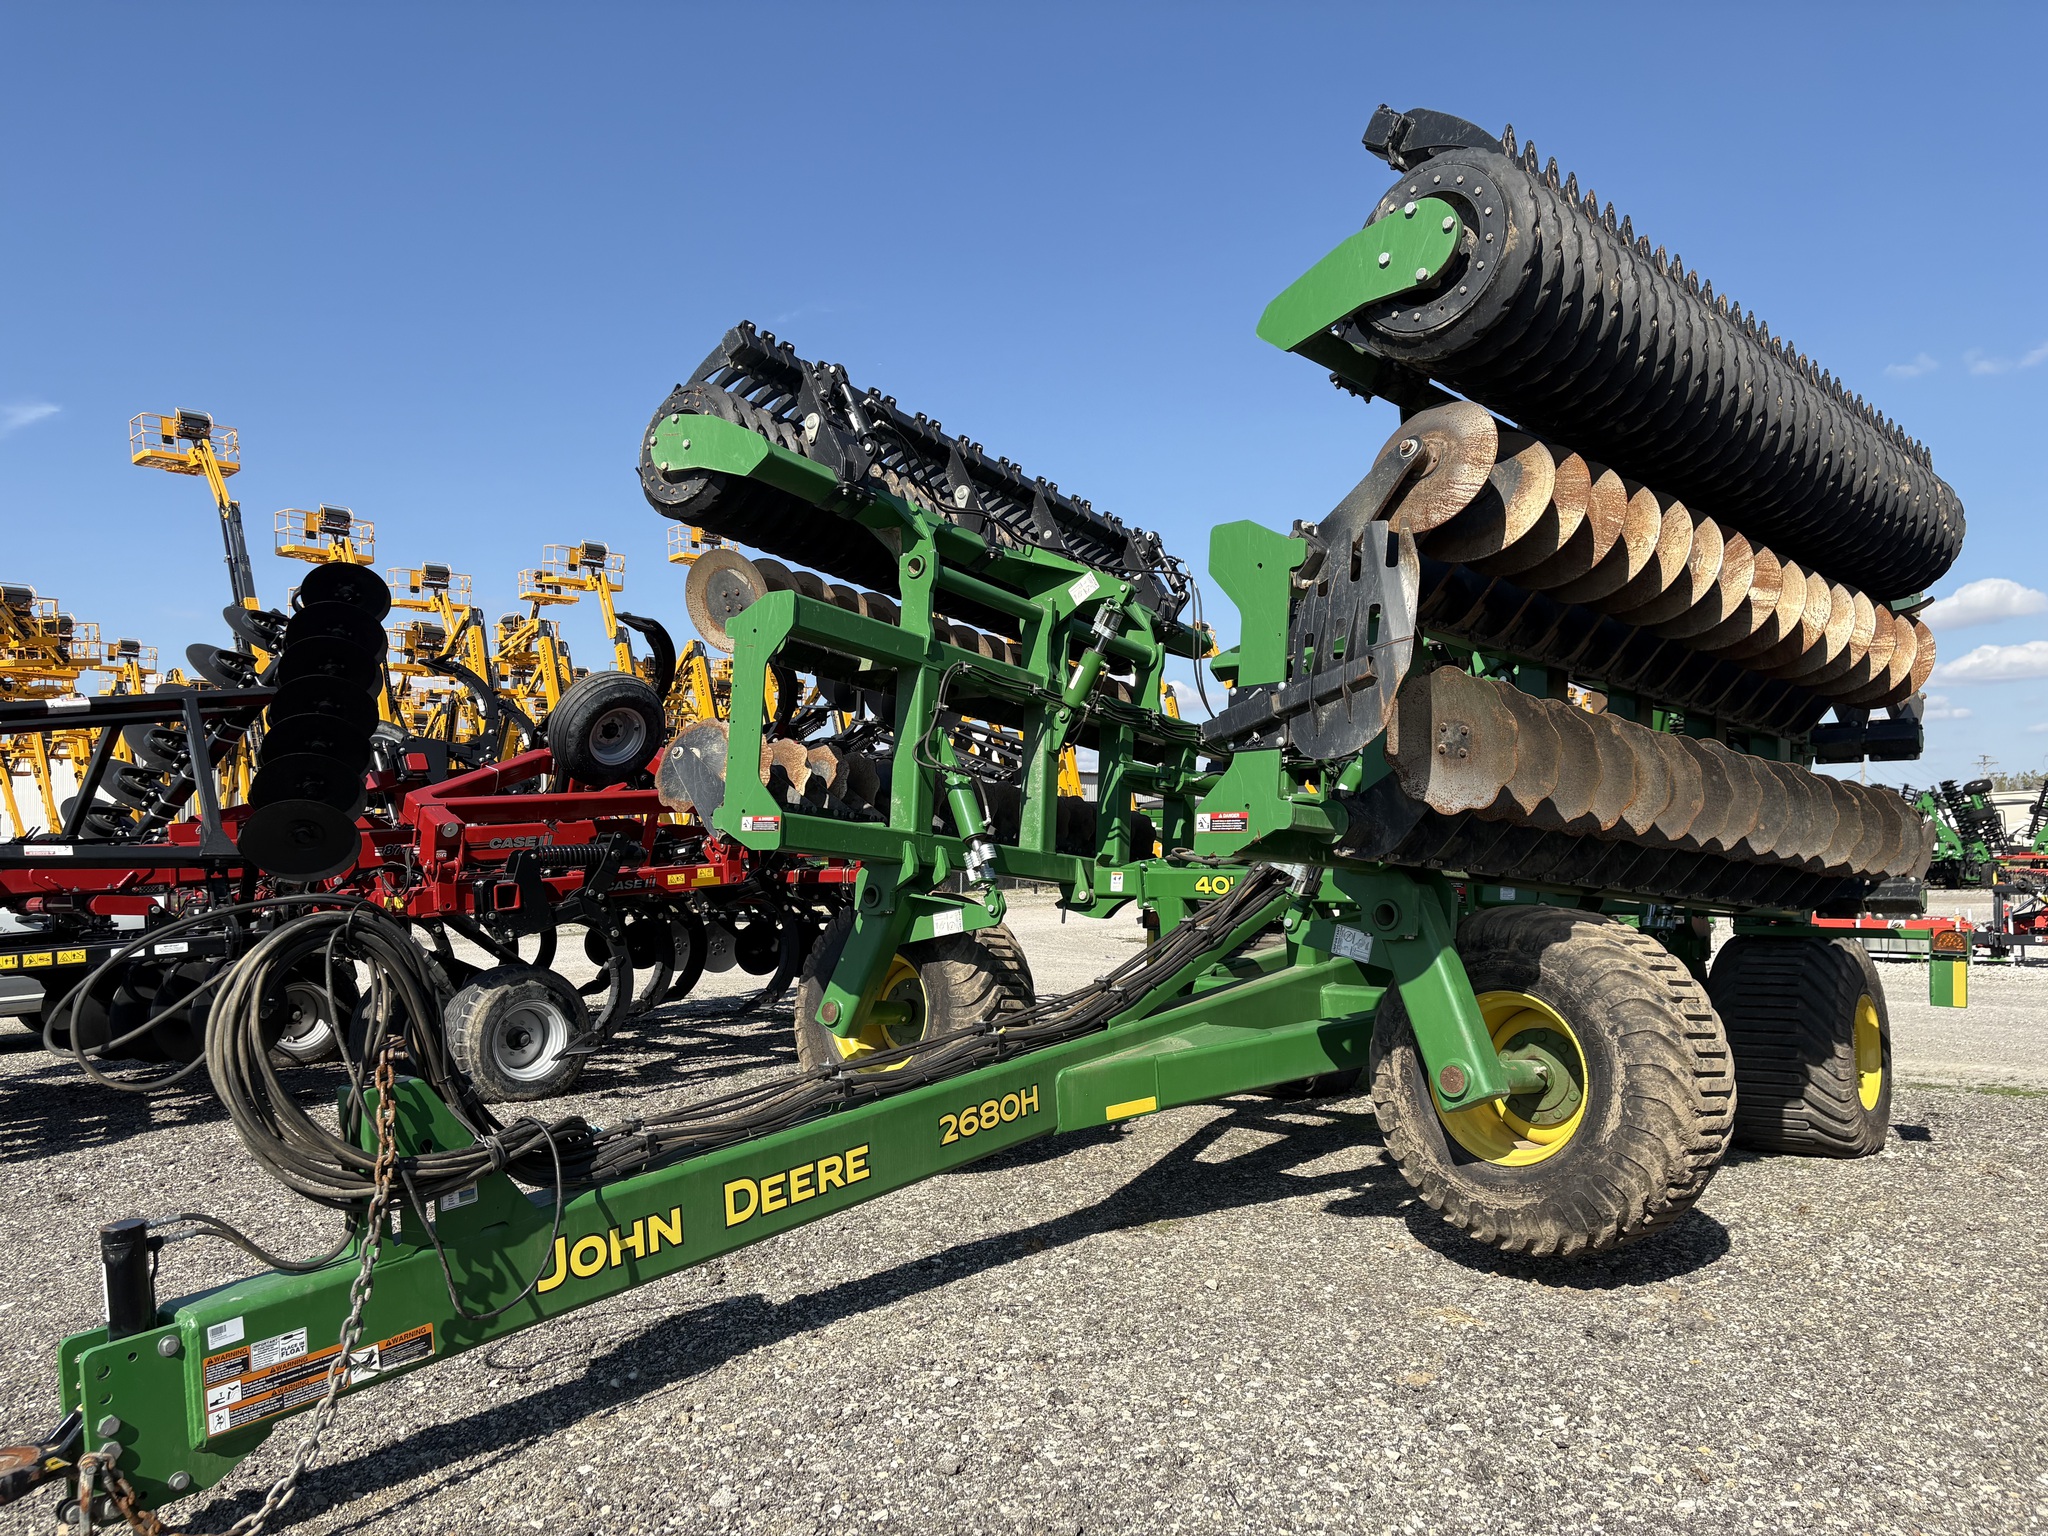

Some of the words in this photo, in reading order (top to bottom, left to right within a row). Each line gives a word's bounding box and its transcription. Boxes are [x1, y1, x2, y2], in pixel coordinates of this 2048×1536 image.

[489, 836, 537, 849] CASE
[938, 1083, 1040, 1148] 2680H
[536, 1204, 683, 1293] JOHN
[723, 1142, 870, 1229] DEERE
[391, 1327, 427, 1344] WARNING
[213, 1348, 248, 1362] WARNING
[280, 1342, 298, 1352] PLACE
[281, 1345, 305, 1358] FLOAT
[275, 1356, 308, 1372] WARNING
[277, 1378, 310, 1395] WARNING
